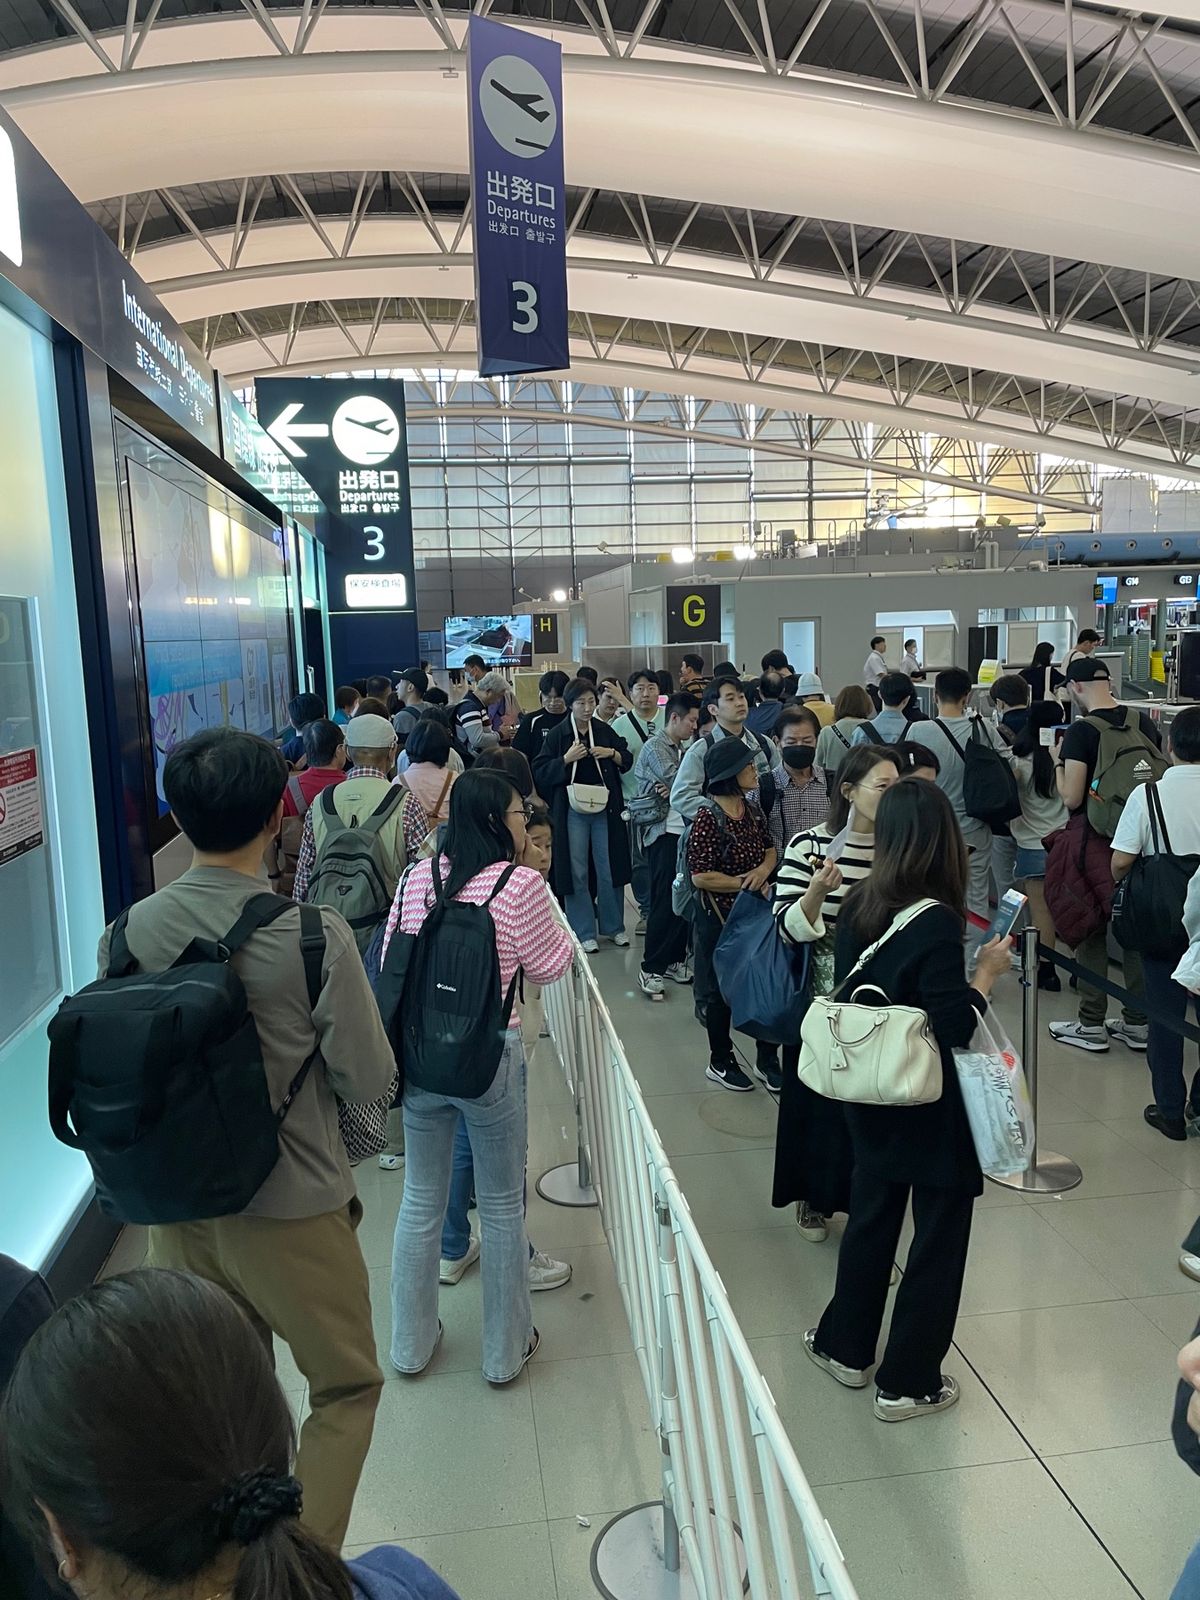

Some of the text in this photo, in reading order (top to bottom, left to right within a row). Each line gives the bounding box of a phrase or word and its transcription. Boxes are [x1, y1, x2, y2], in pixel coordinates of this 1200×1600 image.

[487, 170, 555, 210] 出発口
[487, 199, 556, 229] Departures
[488, 220, 519, 237] 出发口
[525, 227, 556, 245] 출발구
[512, 281, 539, 334] 3
[122, 278, 179, 371] International
[339, 469, 399, 490] 出発口
[339, 490, 400, 504] Departures
[363, 525, 386, 561] 3
[540, 617, 551, 632] H
[683, 594, 706, 628] G
